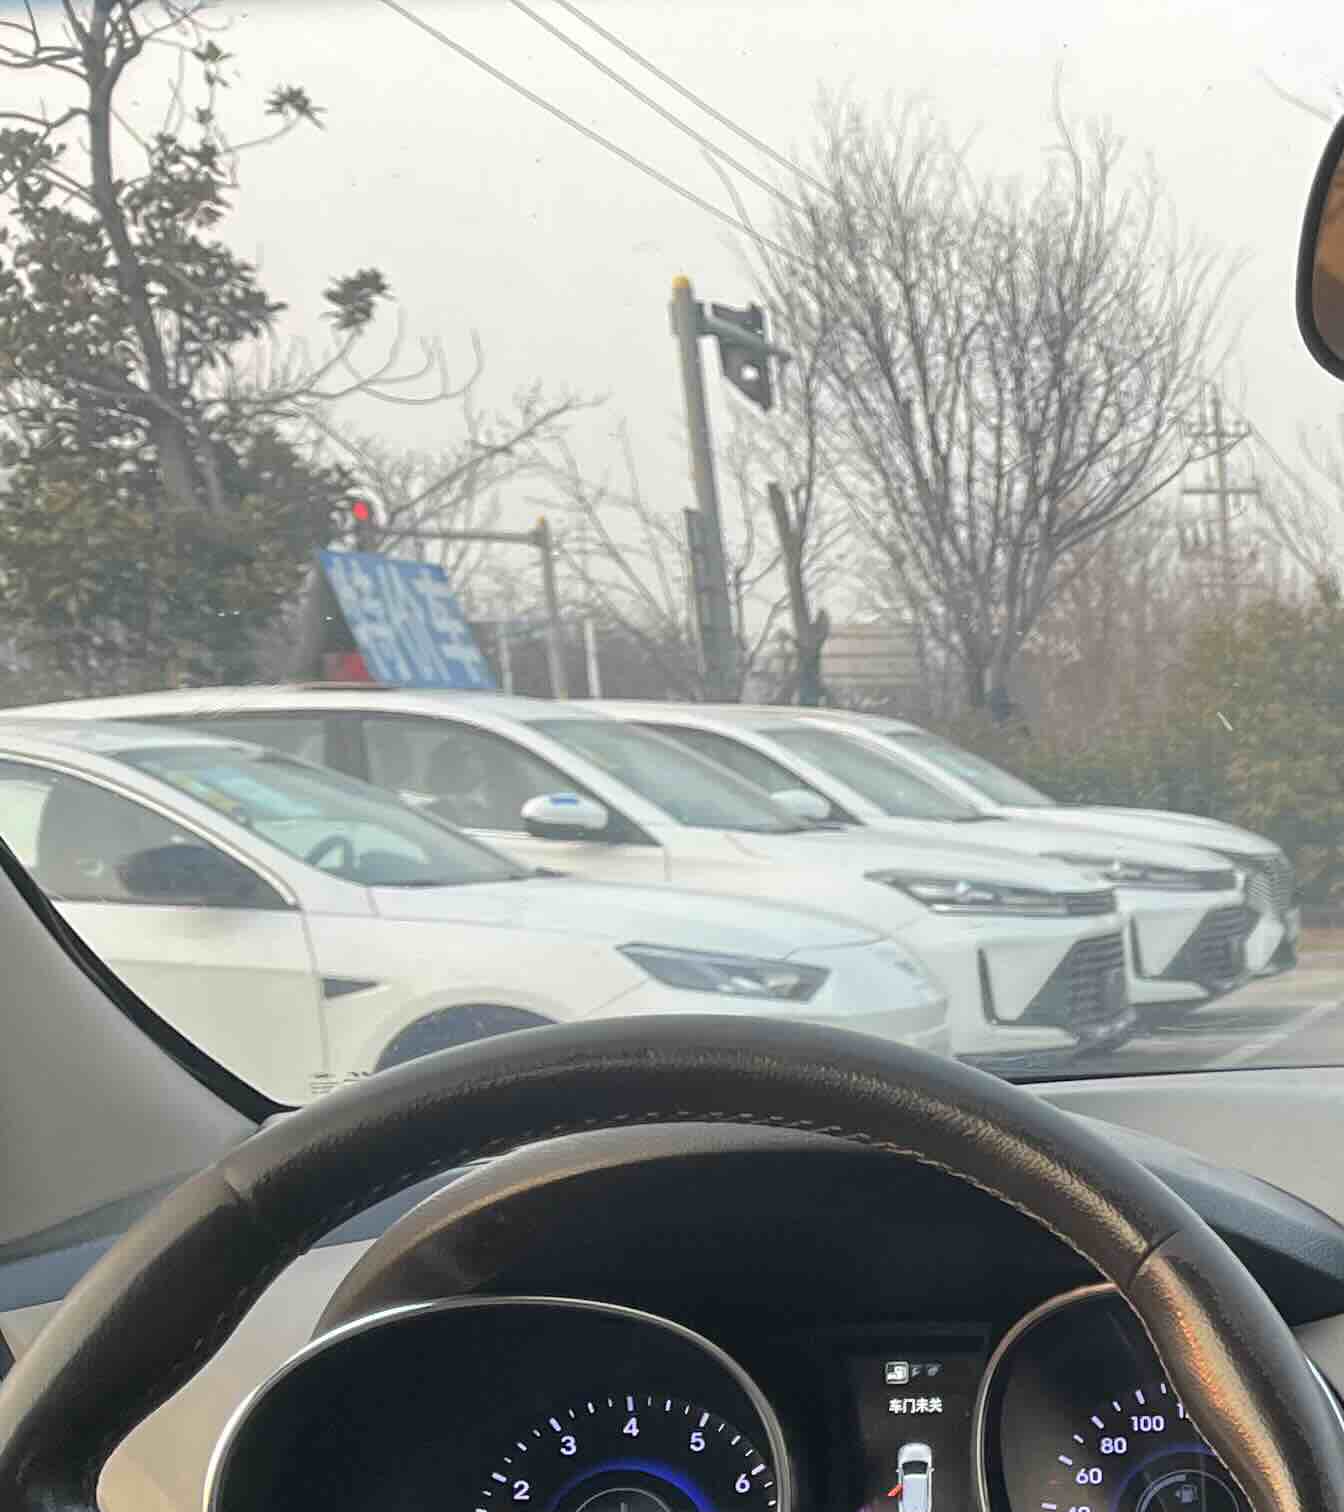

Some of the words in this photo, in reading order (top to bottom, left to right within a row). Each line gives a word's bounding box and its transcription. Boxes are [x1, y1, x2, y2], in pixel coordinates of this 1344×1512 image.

[623, 1418, 640, 1438] 4
[1131, 1415, 1165, 1432] 100
[560, 1435, 577, 1455] 3
[689, 1432, 706, 1452] 5
[1100, 1438, 1127, 1455] 80
[735, 1474, 750, 1493] 6
[1075, 1468, 1103, 1485] 60
[513, 1481, 530, 1500] 2
